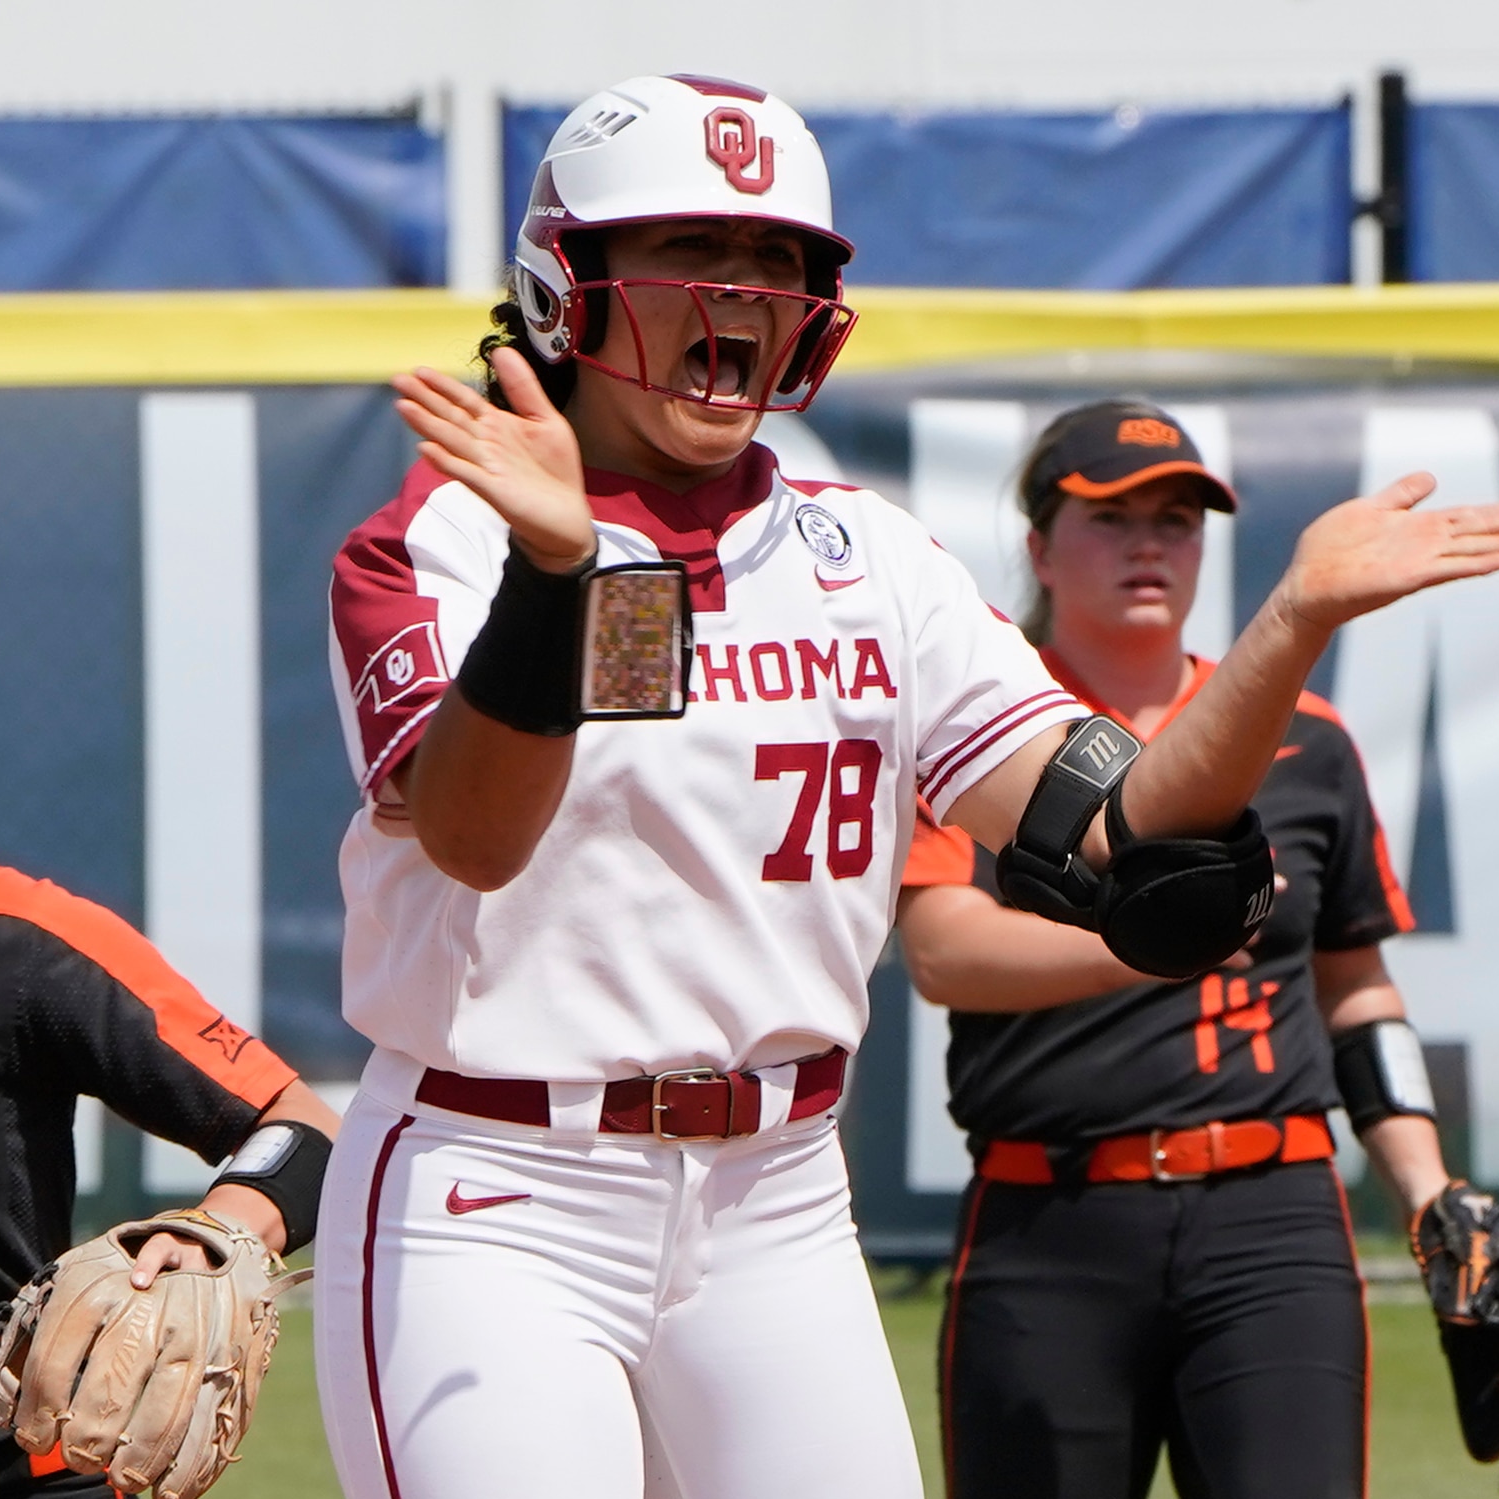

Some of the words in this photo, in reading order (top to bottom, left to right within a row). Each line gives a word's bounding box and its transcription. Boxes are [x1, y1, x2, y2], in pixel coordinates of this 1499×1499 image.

[703, 106, 775, 196] OU
[385, 648, 416, 686] OU
[688, 637, 897, 703] HOMA
[755, 739, 883, 882] 78
[1194, 973, 1281, 1074] 14
